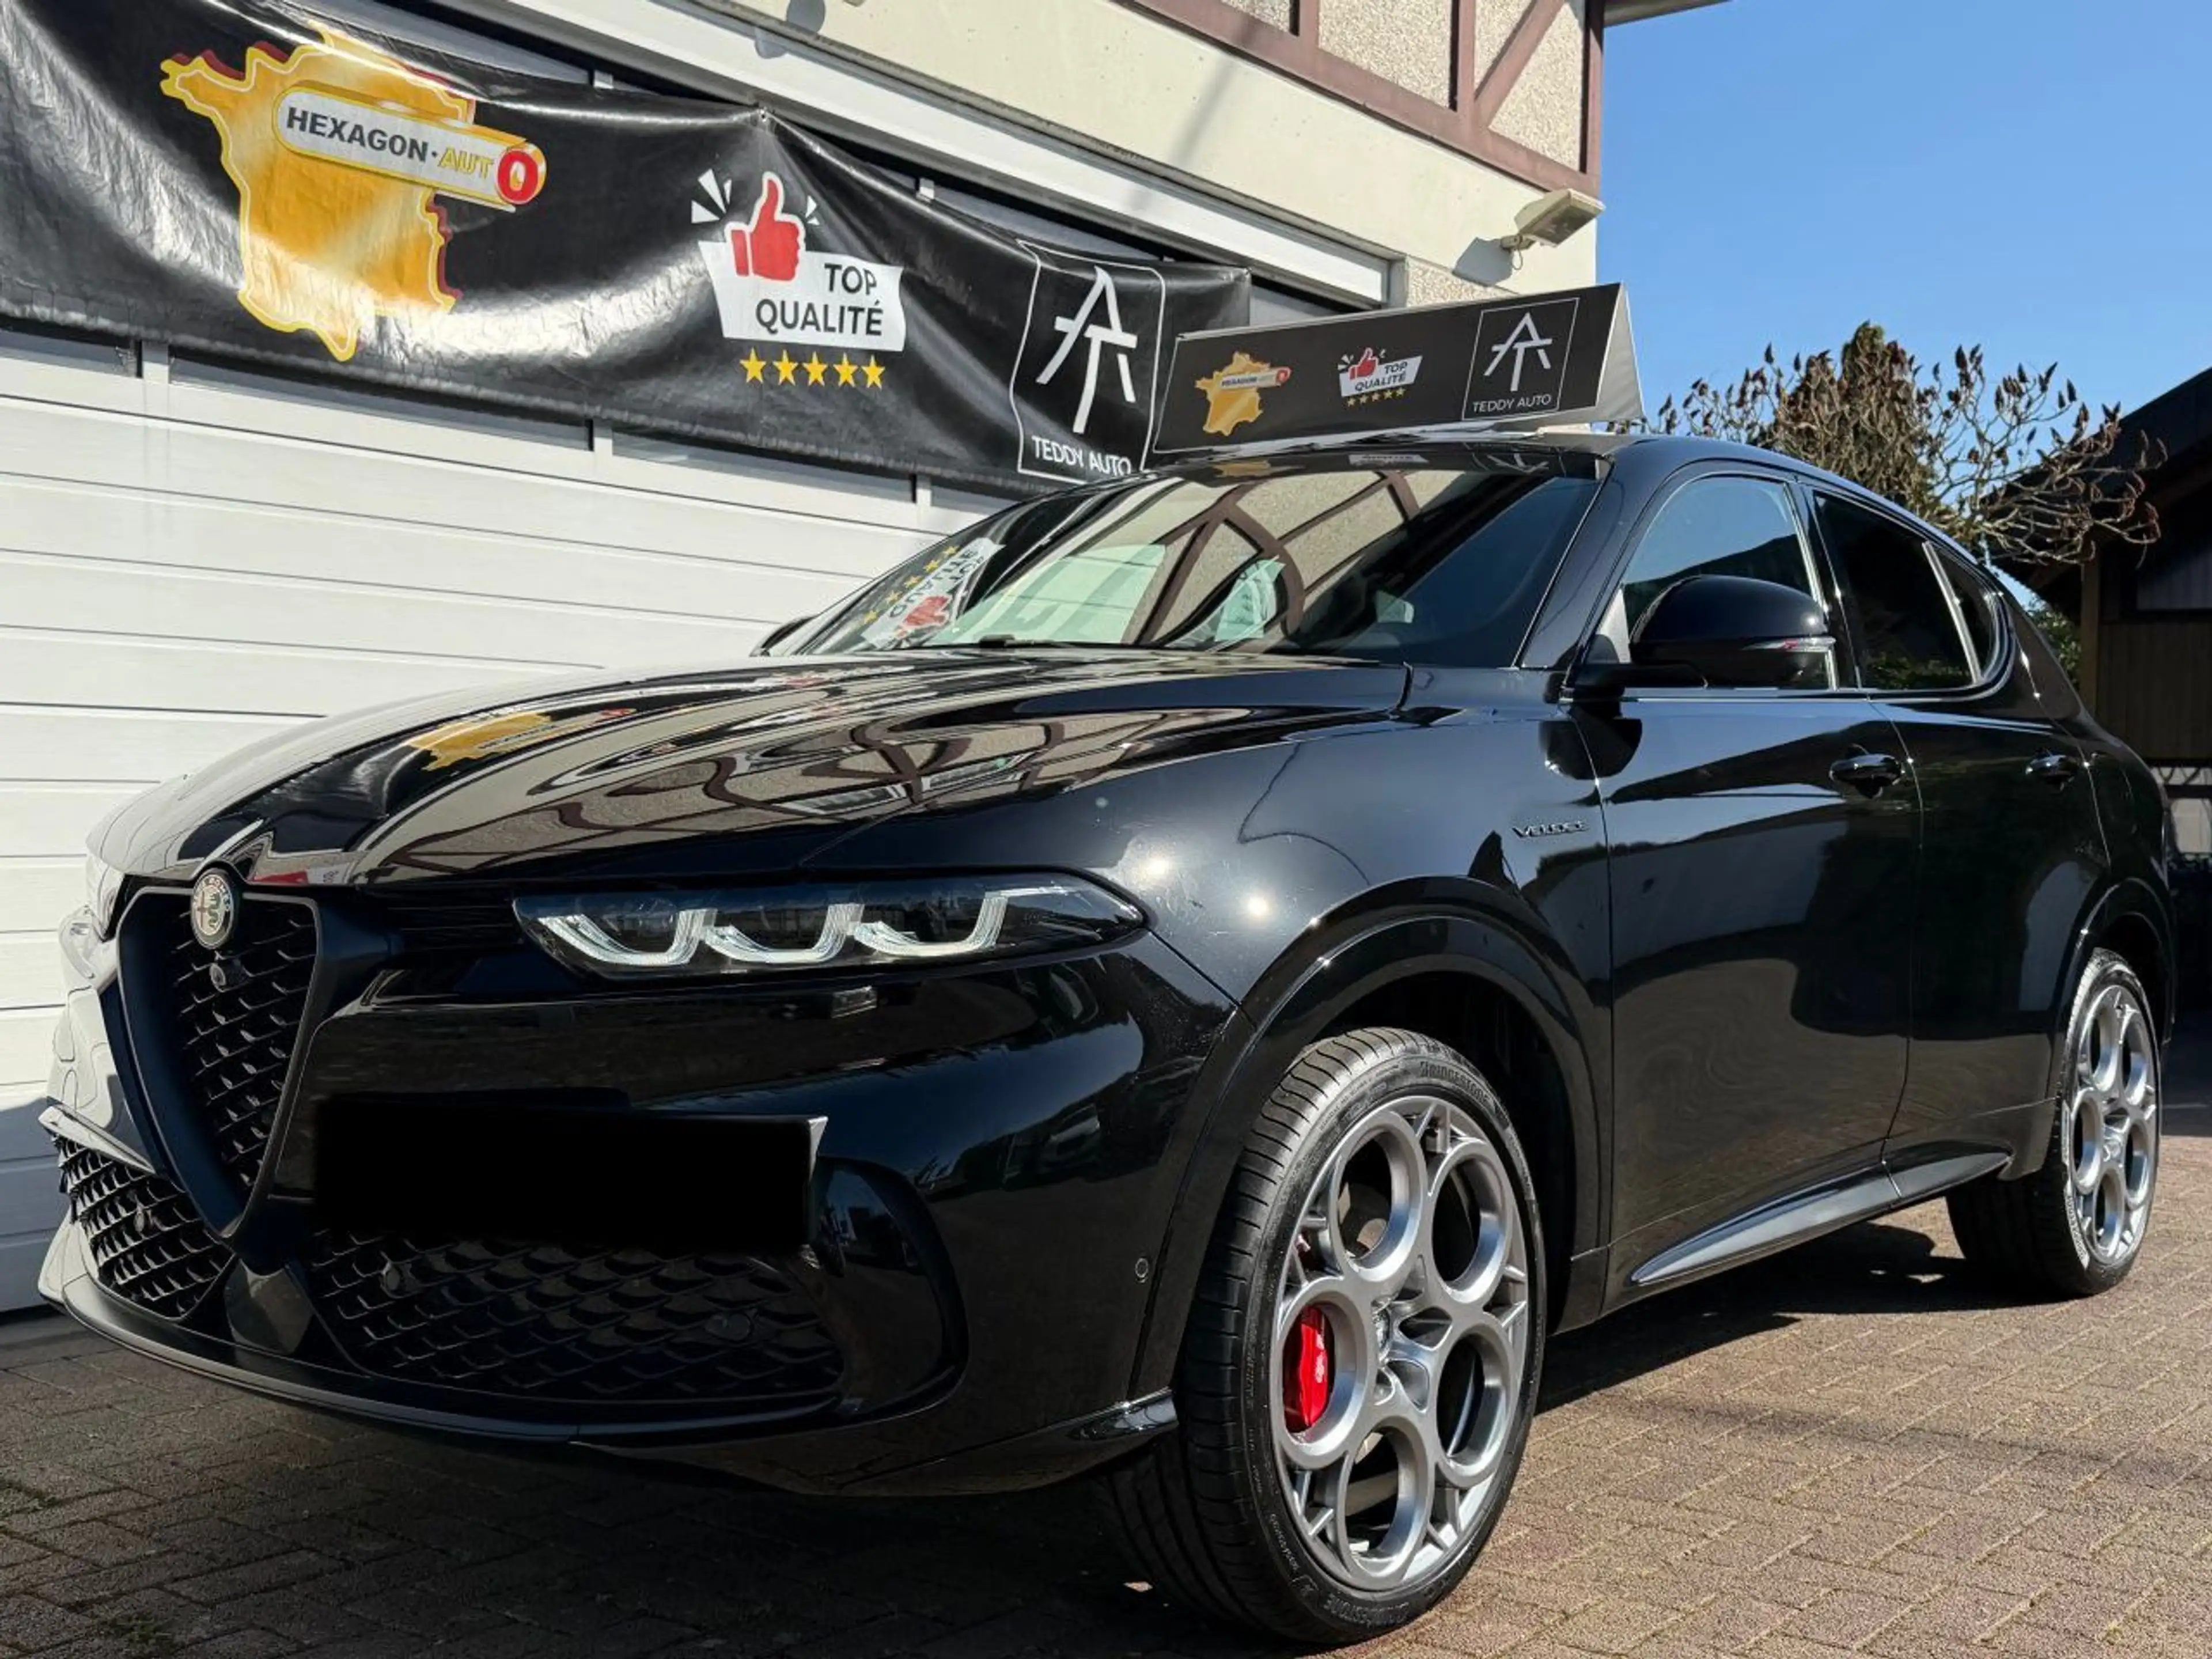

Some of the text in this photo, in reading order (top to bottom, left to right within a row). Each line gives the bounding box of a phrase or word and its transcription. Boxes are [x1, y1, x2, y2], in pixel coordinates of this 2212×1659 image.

[824, 263, 877, 295] TOP
[756, 298, 884, 336] QUALITÉ
[1384, 361, 1408, 374] TOP
[1472, 394, 1552, 412] TEDDY AUTO
[1031, 434, 1132, 476] TEDDY AUTO
